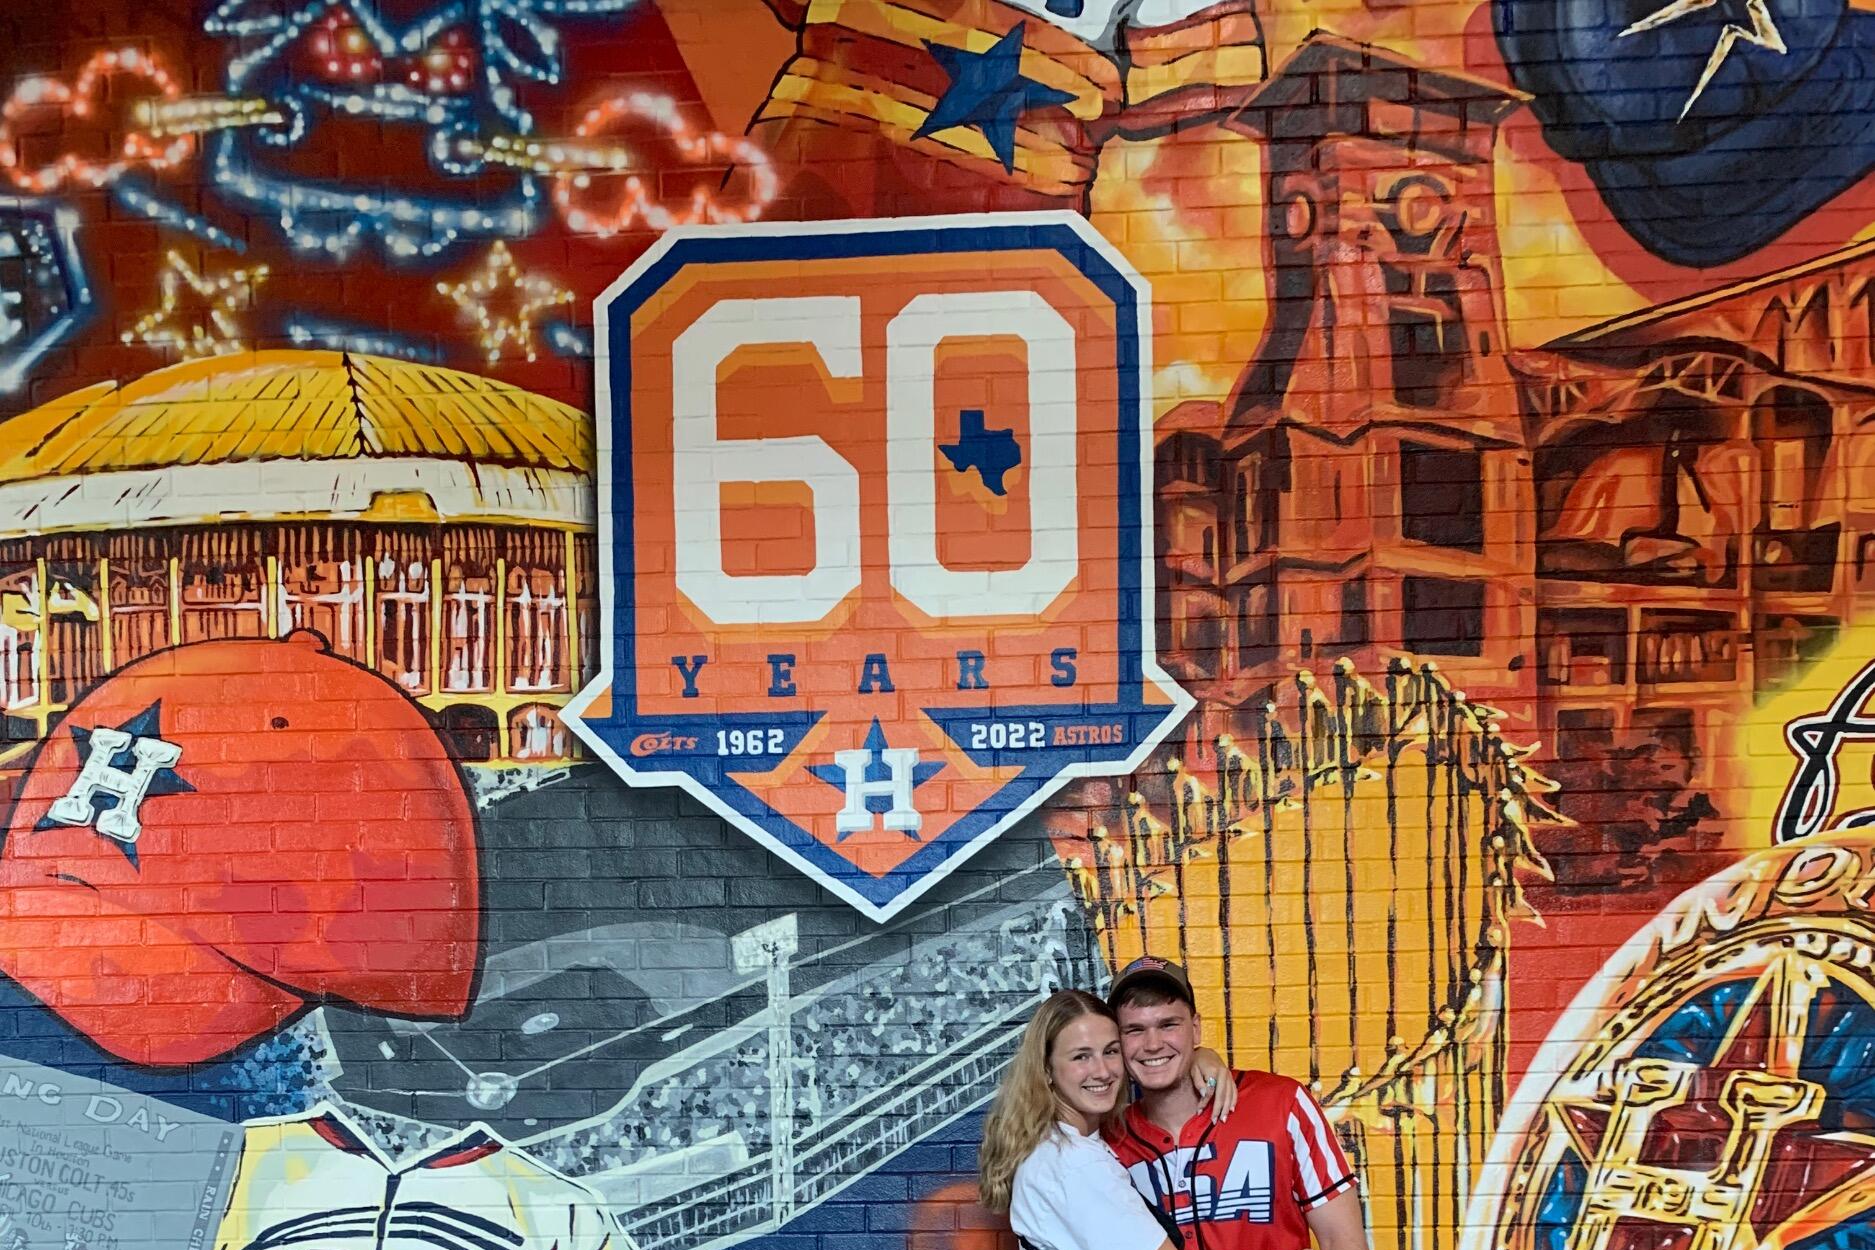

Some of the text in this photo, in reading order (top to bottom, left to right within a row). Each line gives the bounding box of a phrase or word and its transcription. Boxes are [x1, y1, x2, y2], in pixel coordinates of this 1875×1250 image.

[672, 290, 1078, 626] 60
[671, 648, 1078, 698] YEARS
[716, 728, 785, 755] 1962
[971, 721, 1124, 750] 2022 ASTROS
[47, 727, 184, 843] H
[833, 747, 924, 834] H
[83, 1093, 182, 1143] DAY
[16, 1120, 62, 1143] National
[64, 1134, 100, 1156] League
[59, 1163, 105, 1195] COLT
[68, 1200, 116, 1232] CUBS
[199, 1184, 217, 1221] RAIN
